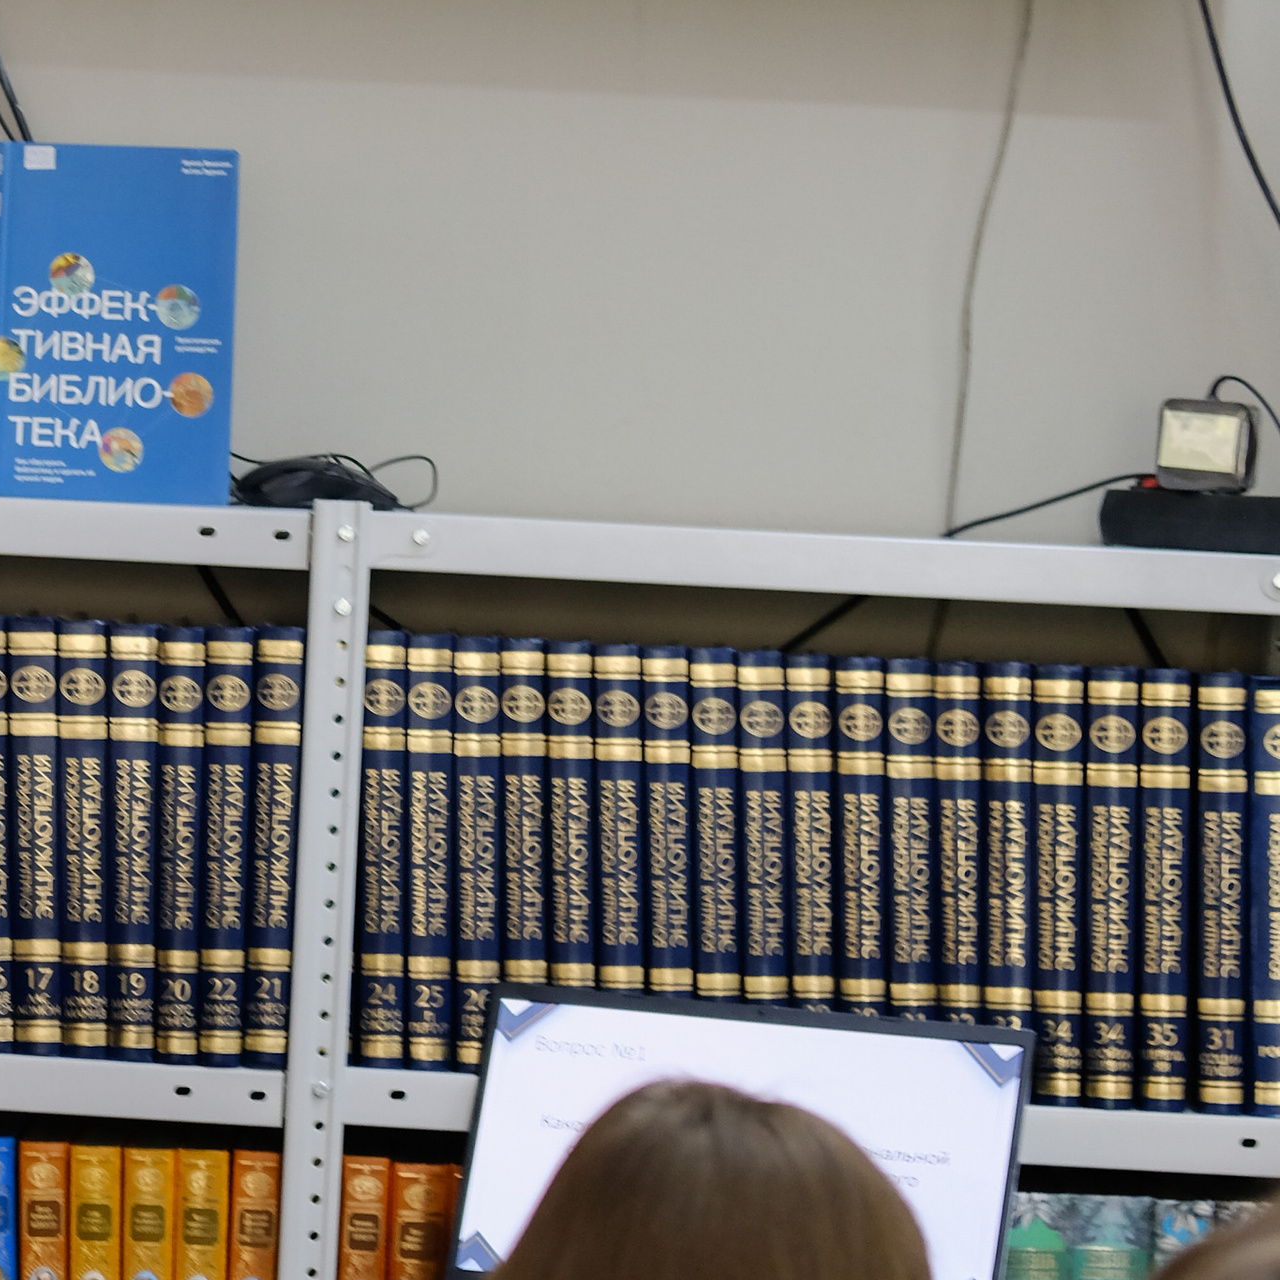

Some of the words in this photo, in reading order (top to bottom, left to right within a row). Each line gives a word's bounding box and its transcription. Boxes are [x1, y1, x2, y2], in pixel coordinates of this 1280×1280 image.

[12, 284, 160, 322] ЭФФЕК-
[12, 328, 163, 366] ТИВНАЯ
[8, 372, 175, 411] БИБЛИО-
[10, 417, 103, 452] ТЕКА
[33, 753, 54, 919] ЭНЦИКЛОПЕДИЯ
[81, 757, 103, 922] ЭНЦИКЛОПЕДИЯ
[222, 764, 243, 928] ЭНЦИКЛОПЕДИЯ
[380, 768, 401, 932] ЭНЦИКЛОПЕДИЯ
[428, 771, 448, 935] ЭНЦИКЛОПЕДИЯ
[567, 776, 589, 942] ЭНЦИКЛОПЕДИЯ
[714, 787, 736, 952] ЭНЦИКЛОПЕДИЯ
[859, 793, 880, 959] ЭНЦИКЛОПЕДИЯ
[1004, 799, 1026, 967] ЭНЦИКЛОПЕДИЯ
[1055, 802, 1077, 971] ЭНЦИКЛОПЕДИЯ
[1161, 806, 1184, 973] ЭНЦИКЛОПЕДИЯ
[25, 966, 54, 991] 17
[72, 969, 100, 994] 18
[117, 972, 147, 997] 19
[207, 977, 237, 1002] 22
[254, 976, 282, 1000] 21
[368, 982, 398, 1006] 24
[414, 984, 445, 1009] 25
[1041, 1019, 1074, 1043] 34
[1094, 1021, 1126, 1045] 34
[1146, 1022, 1179, 1047] 35
[1206, 1026, 1235, 1051] 31
[540, 1114, 585, 1131] Како
